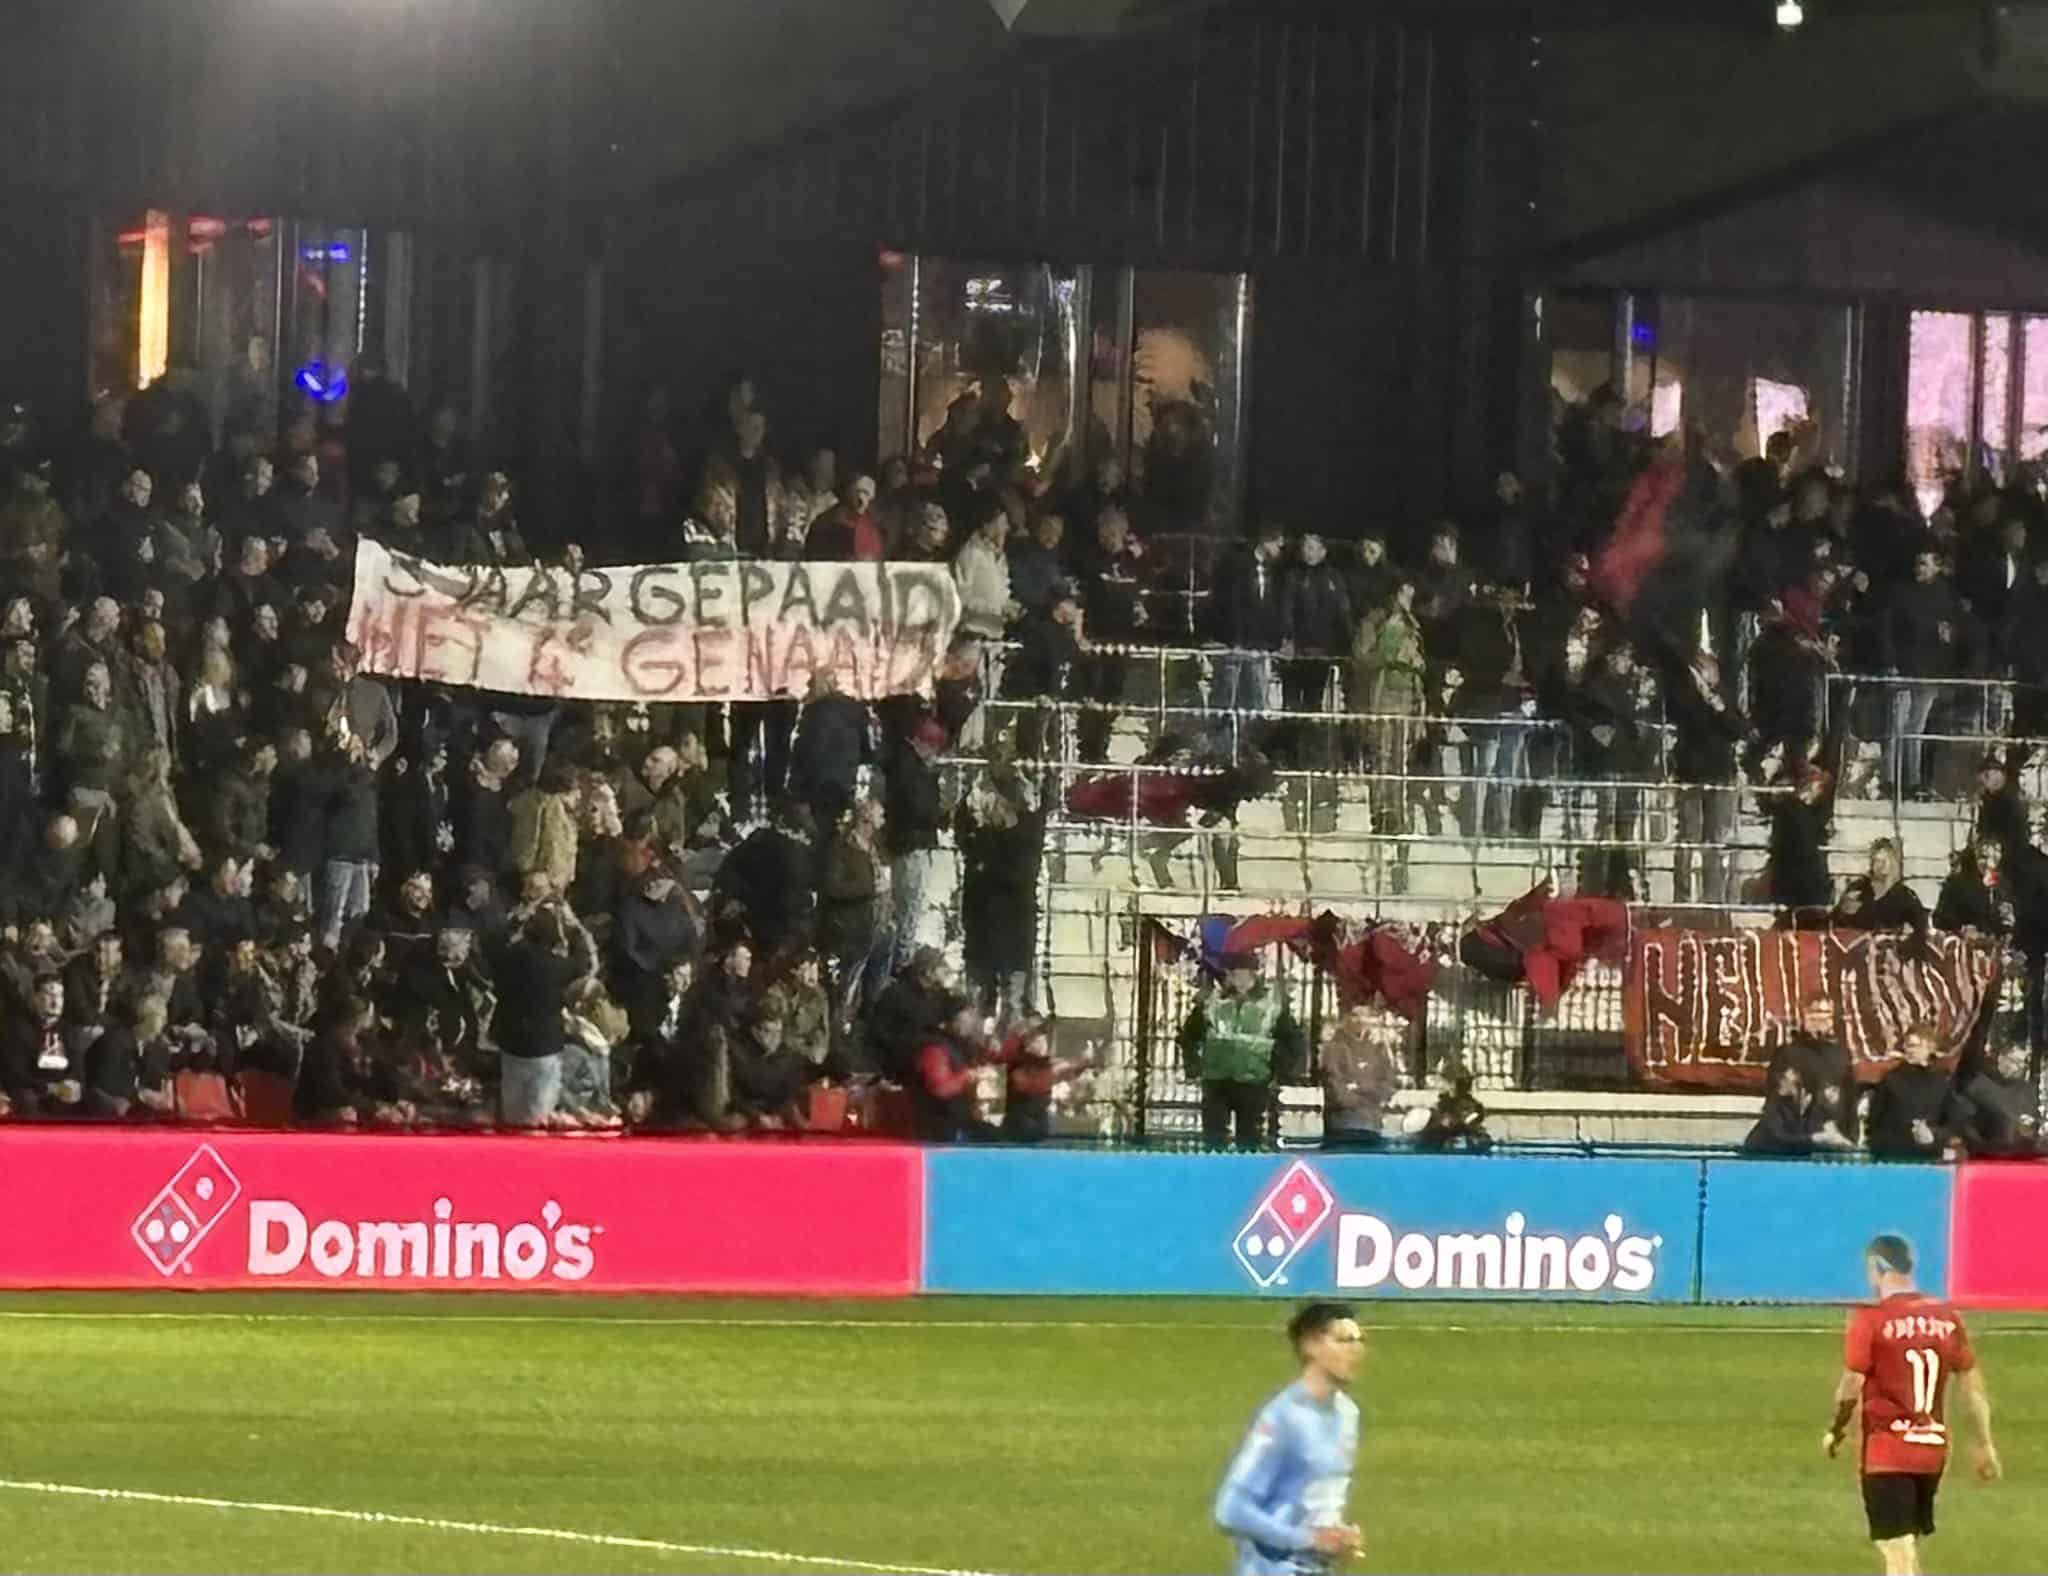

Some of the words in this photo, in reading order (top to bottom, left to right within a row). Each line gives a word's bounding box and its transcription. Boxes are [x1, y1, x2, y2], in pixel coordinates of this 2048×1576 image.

[630, 562, 946, 635] GEPAAID
[248, 1197, 596, 1281] Domino's
[1337, 1210, 1656, 1291] Domino's
[1905, 1348, 1940, 1414] 11
